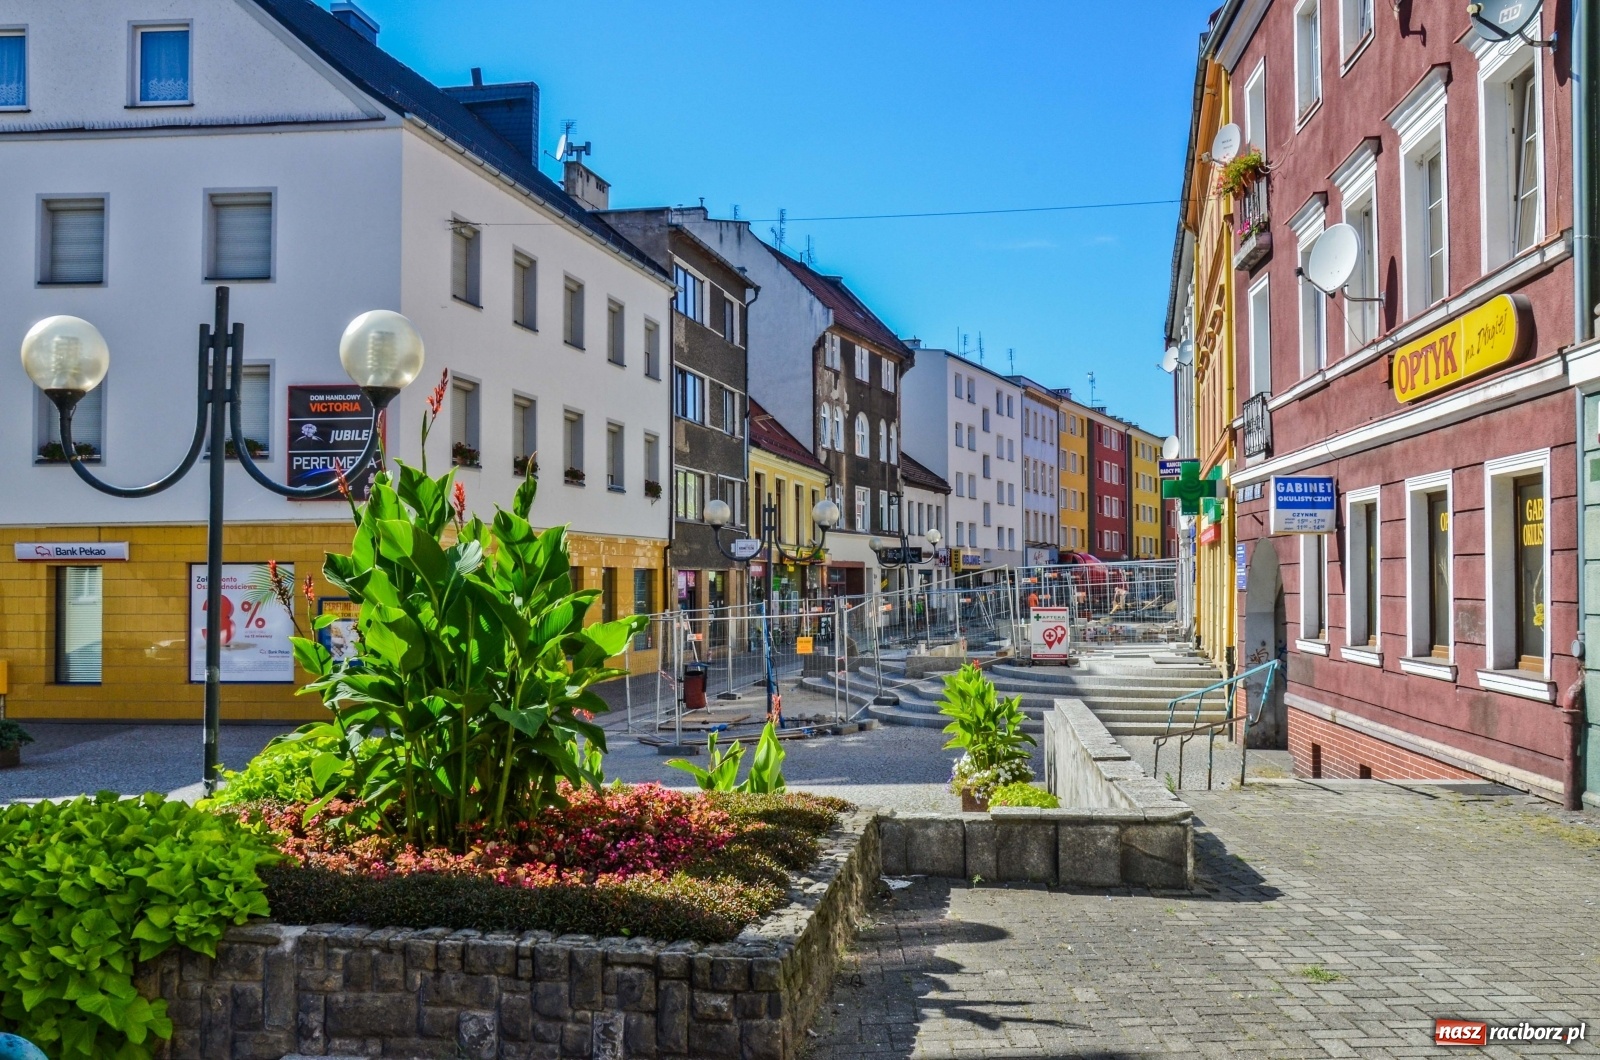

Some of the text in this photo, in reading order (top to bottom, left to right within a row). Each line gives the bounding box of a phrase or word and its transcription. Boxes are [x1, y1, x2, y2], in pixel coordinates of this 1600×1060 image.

[1500, 6, 1519, 21] HD
[1397, 331, 1458, 394] OPTYK
[309, 402, 361, 412] VICTORIA
[329, 429, 371, 444] JUBILE
[1276, 482, 1333, 493] GABINET
[1526, 498, 1544, 521] GAB
[55, 547, 106, 556] Bank Pekao
